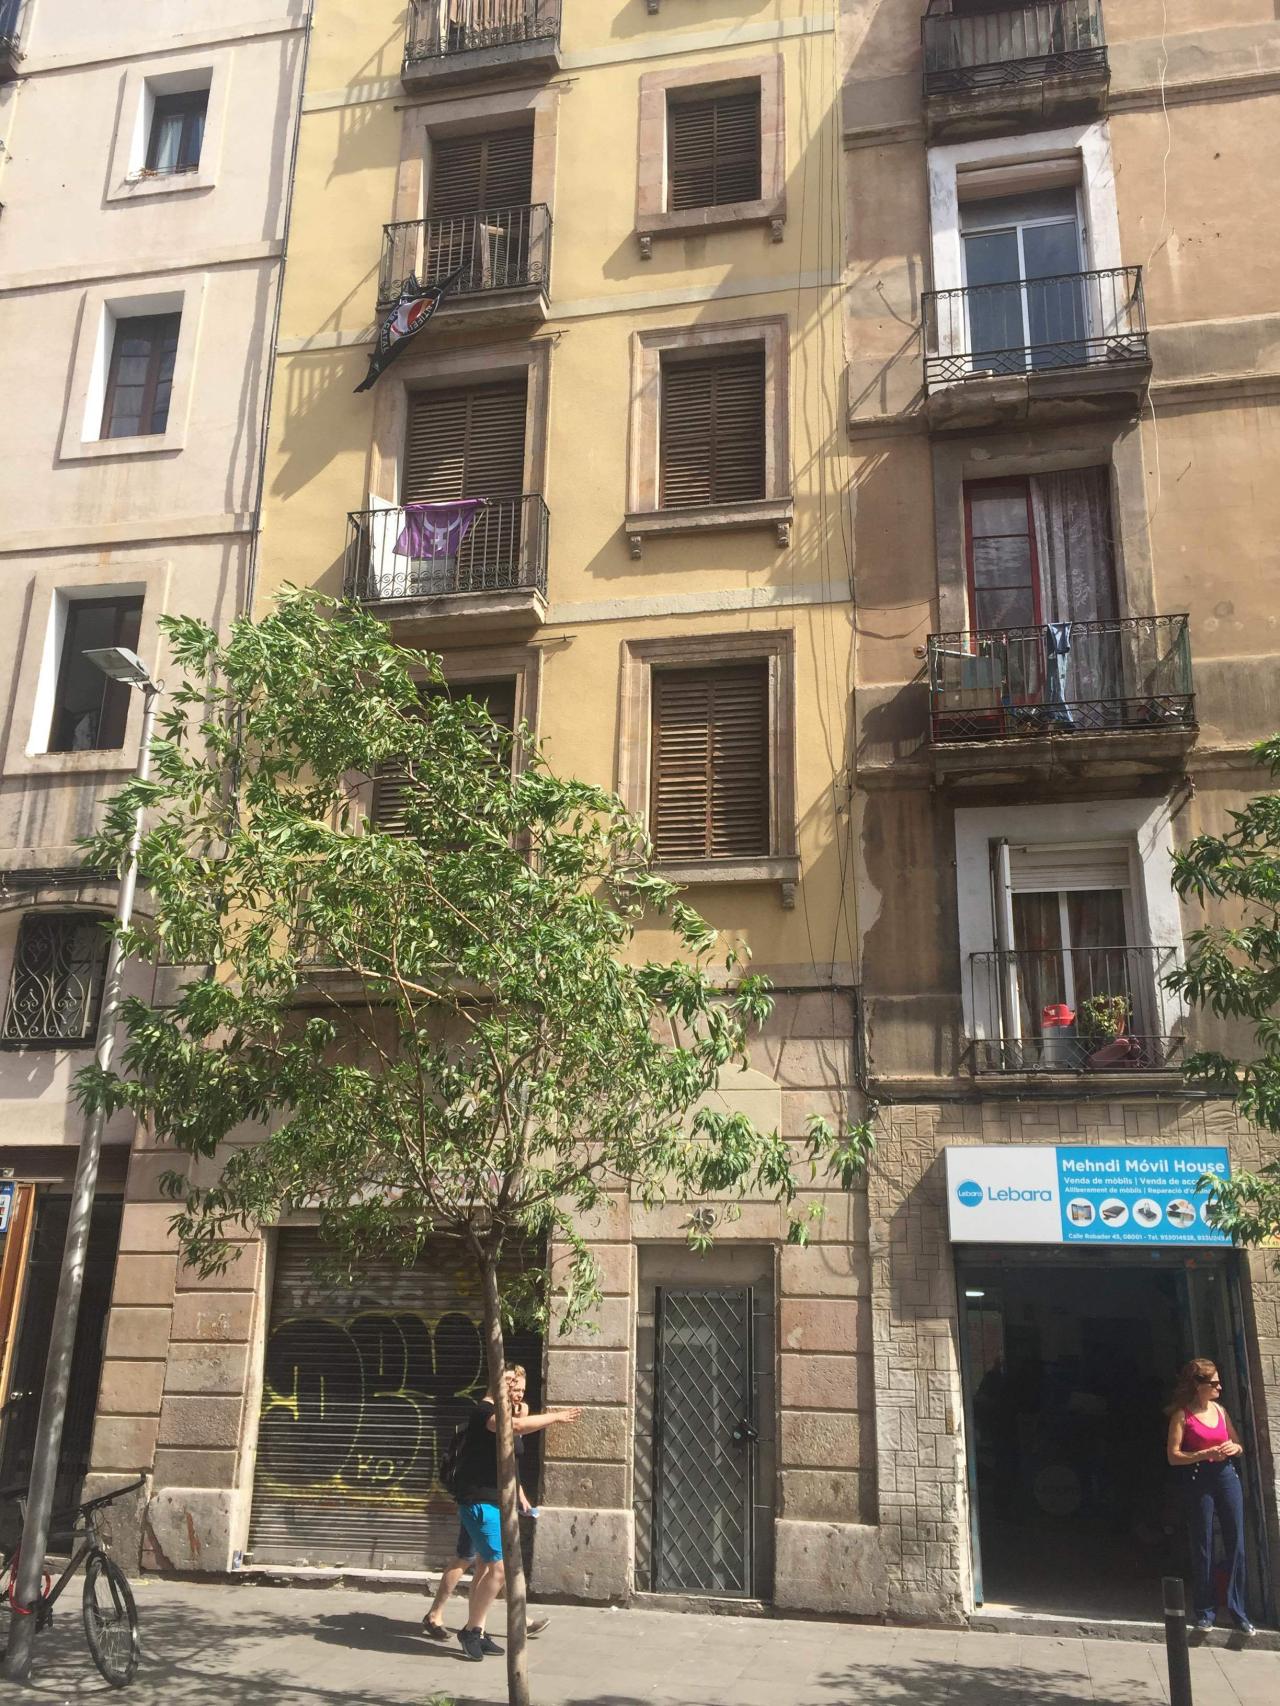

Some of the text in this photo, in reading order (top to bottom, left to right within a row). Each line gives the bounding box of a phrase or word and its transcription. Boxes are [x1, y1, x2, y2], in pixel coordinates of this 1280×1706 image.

[1062, 1158, 1225, 1173] Mehndi Móvil House
[988, 1186, 1052, 1201] Lebara
